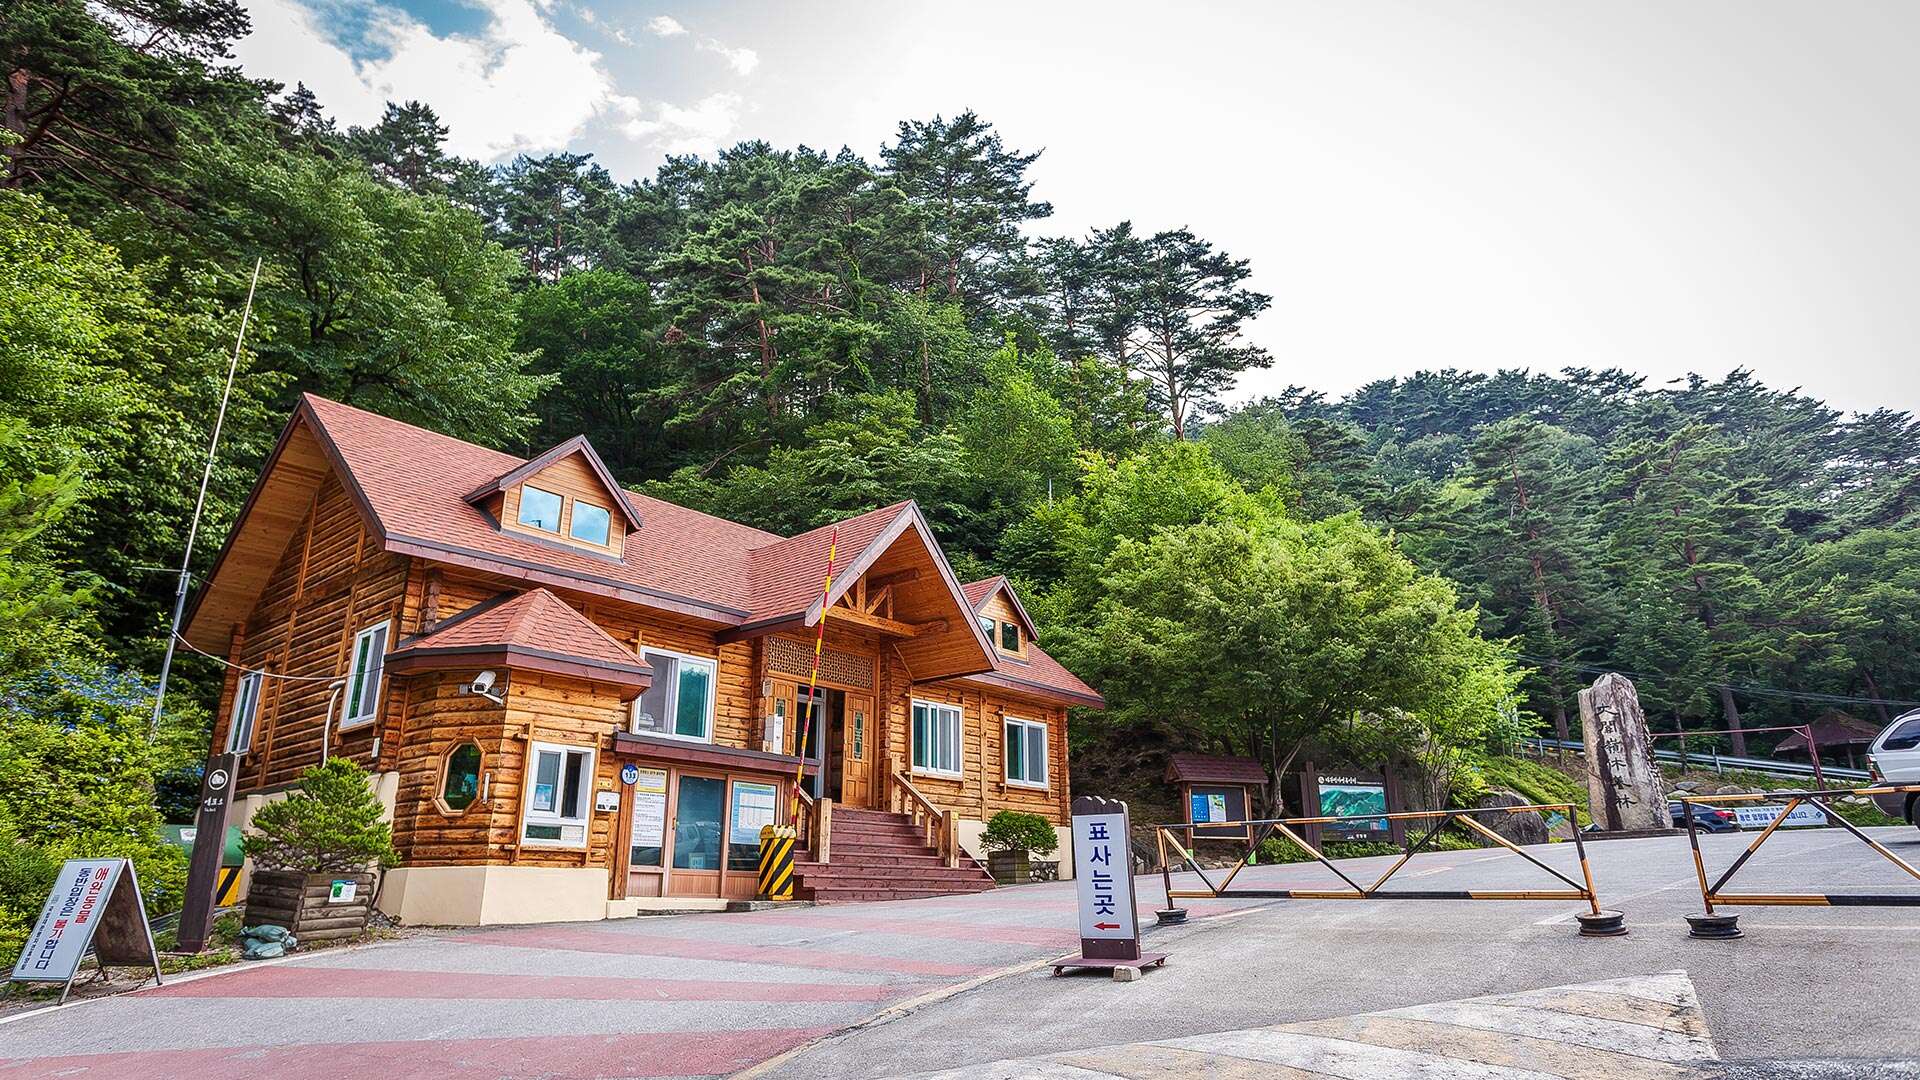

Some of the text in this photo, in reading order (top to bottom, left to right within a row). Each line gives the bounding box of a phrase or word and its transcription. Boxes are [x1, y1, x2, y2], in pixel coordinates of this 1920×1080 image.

[59, 867, 92, 917] 동반입장은
[75, 866, 110, 924] 애완동물
[1088, 821, 1116, 916] 표사는곳
[34, 919, 68, 970] 불가합니다
